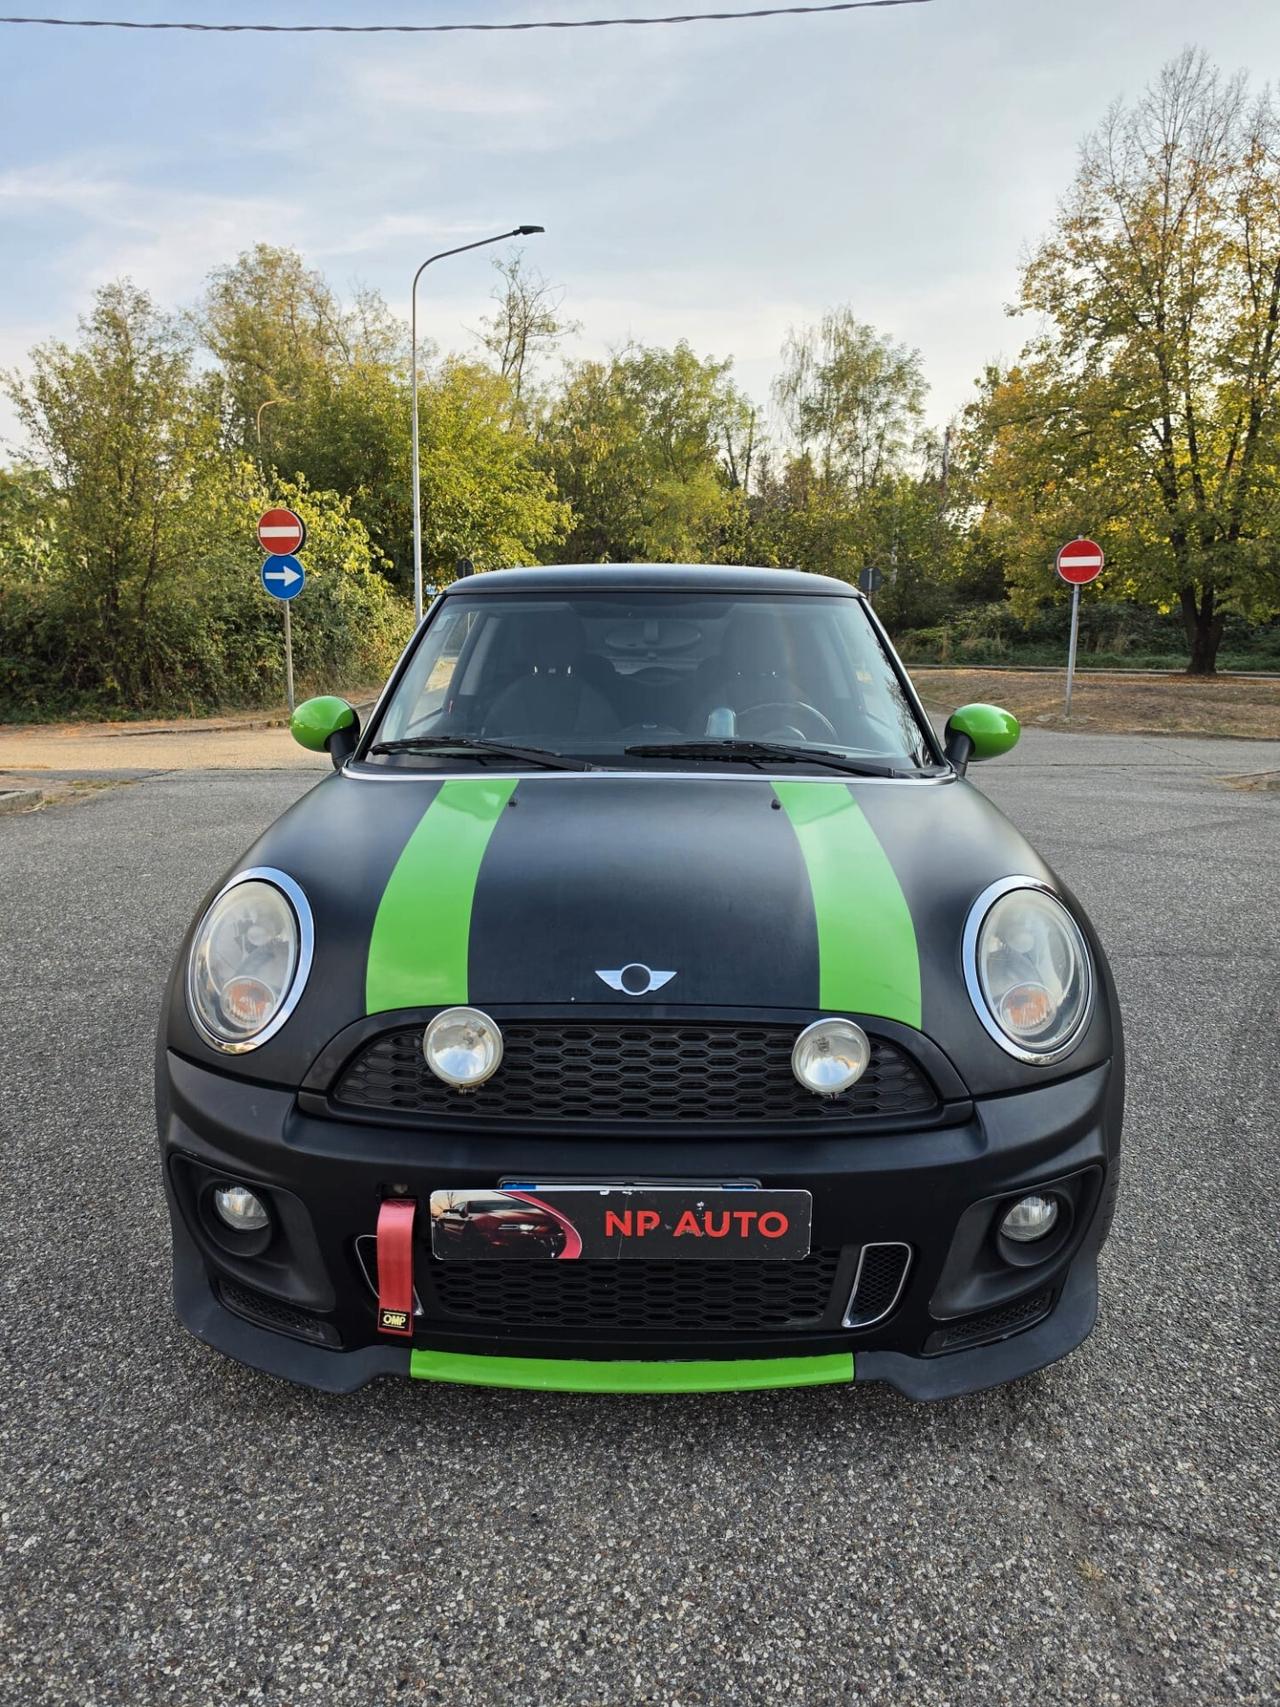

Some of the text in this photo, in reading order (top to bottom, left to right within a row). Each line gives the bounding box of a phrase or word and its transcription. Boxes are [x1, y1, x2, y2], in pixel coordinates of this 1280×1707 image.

[605, 1210, 789, 1238] NP AUTO
[383, 1314, 406, 1326] OMP
